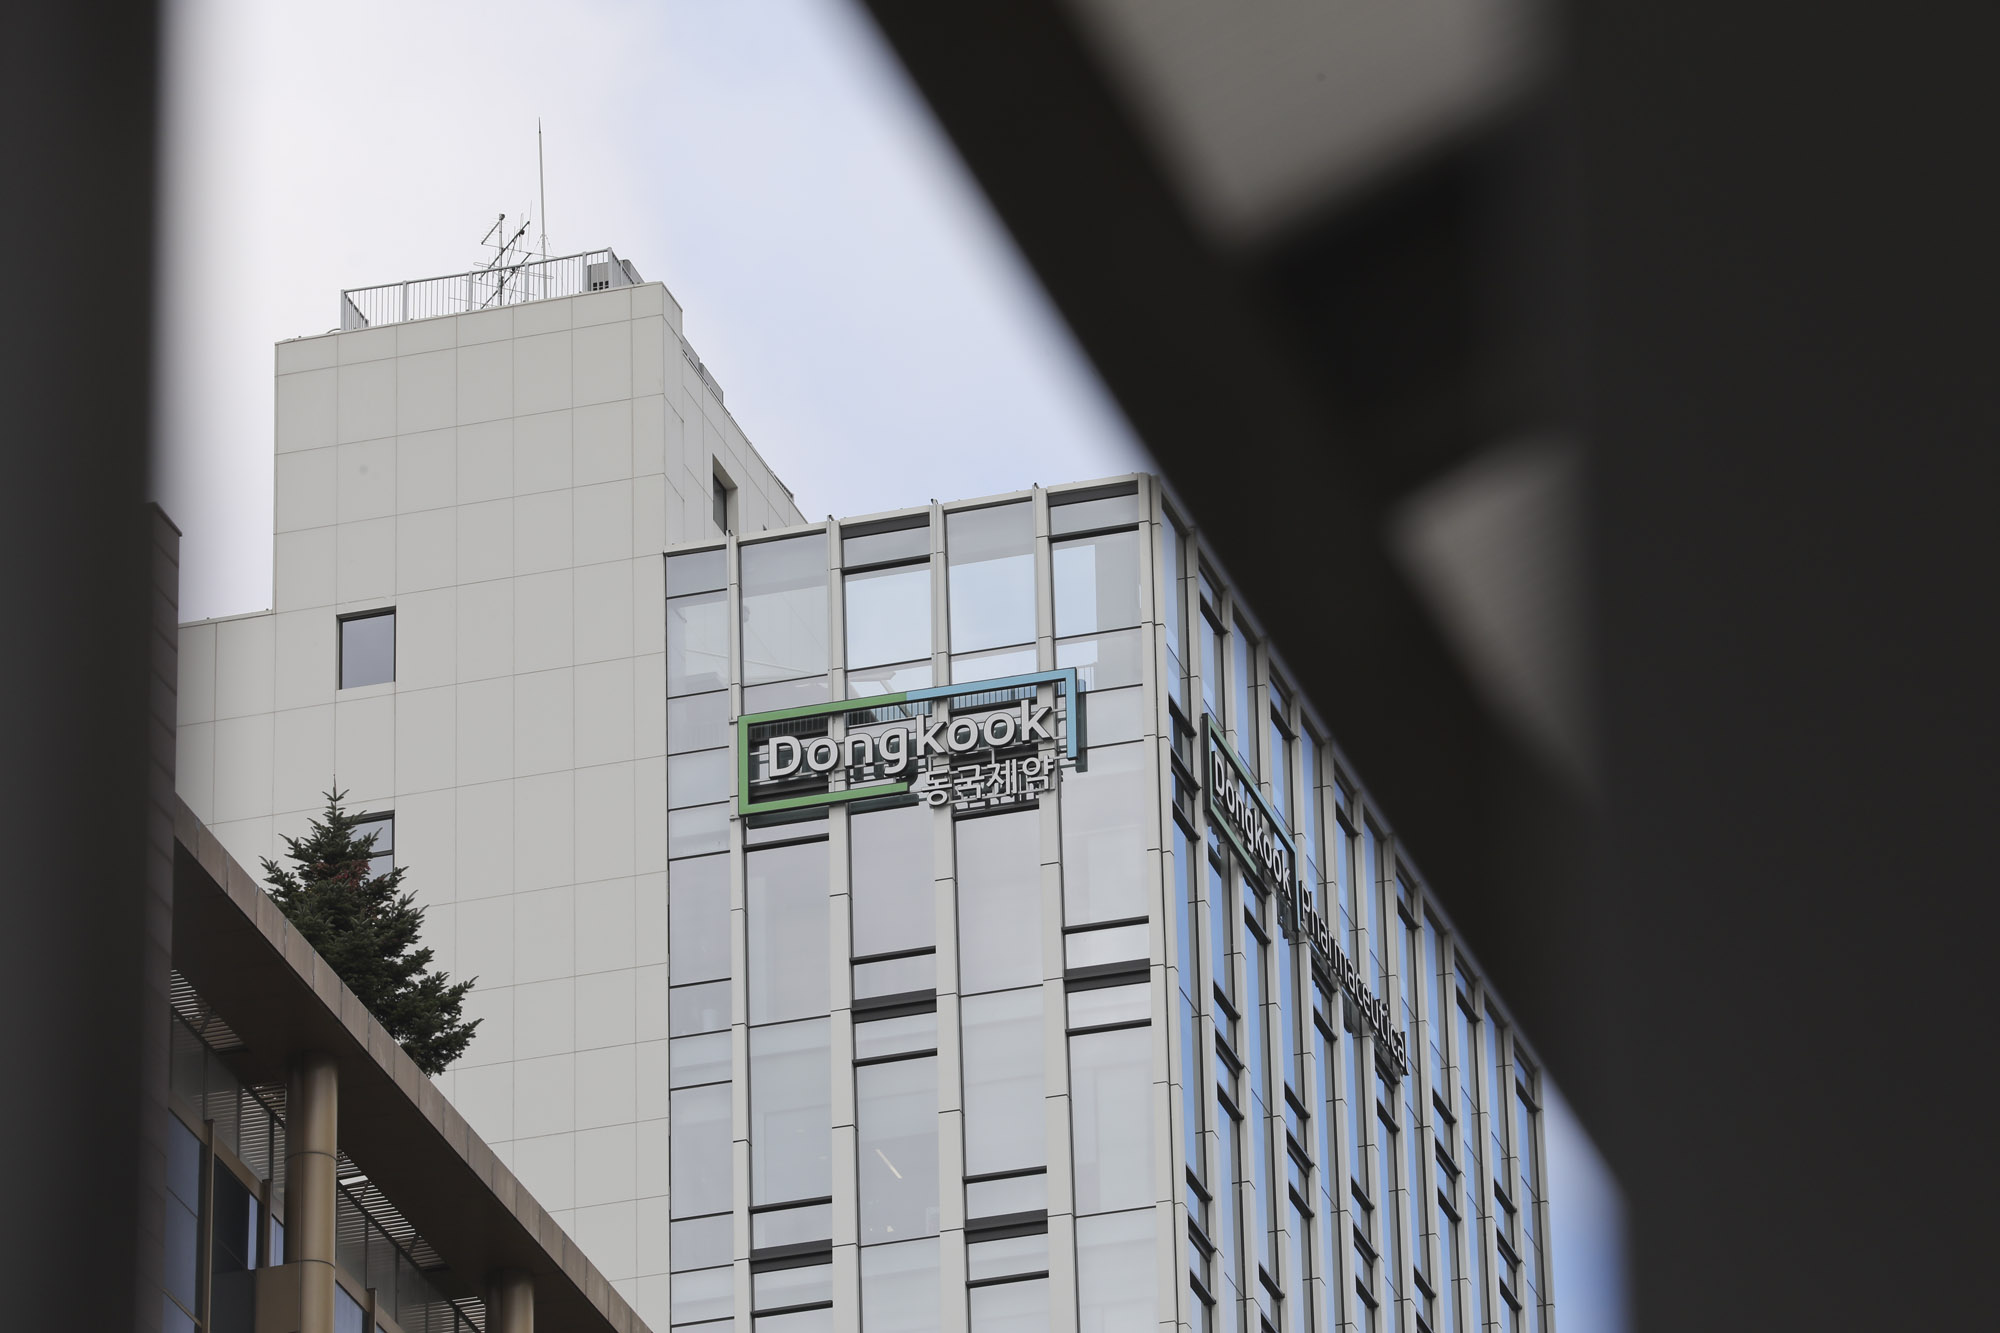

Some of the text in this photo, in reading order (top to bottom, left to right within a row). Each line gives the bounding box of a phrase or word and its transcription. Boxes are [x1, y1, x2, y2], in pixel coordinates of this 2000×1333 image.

[768, 699, 1055, 780] Dongkook
[921, 754, 1055, 806] 동국제약
[1212, 750, 1409, 1076] Dongkook Pharmaceutical
